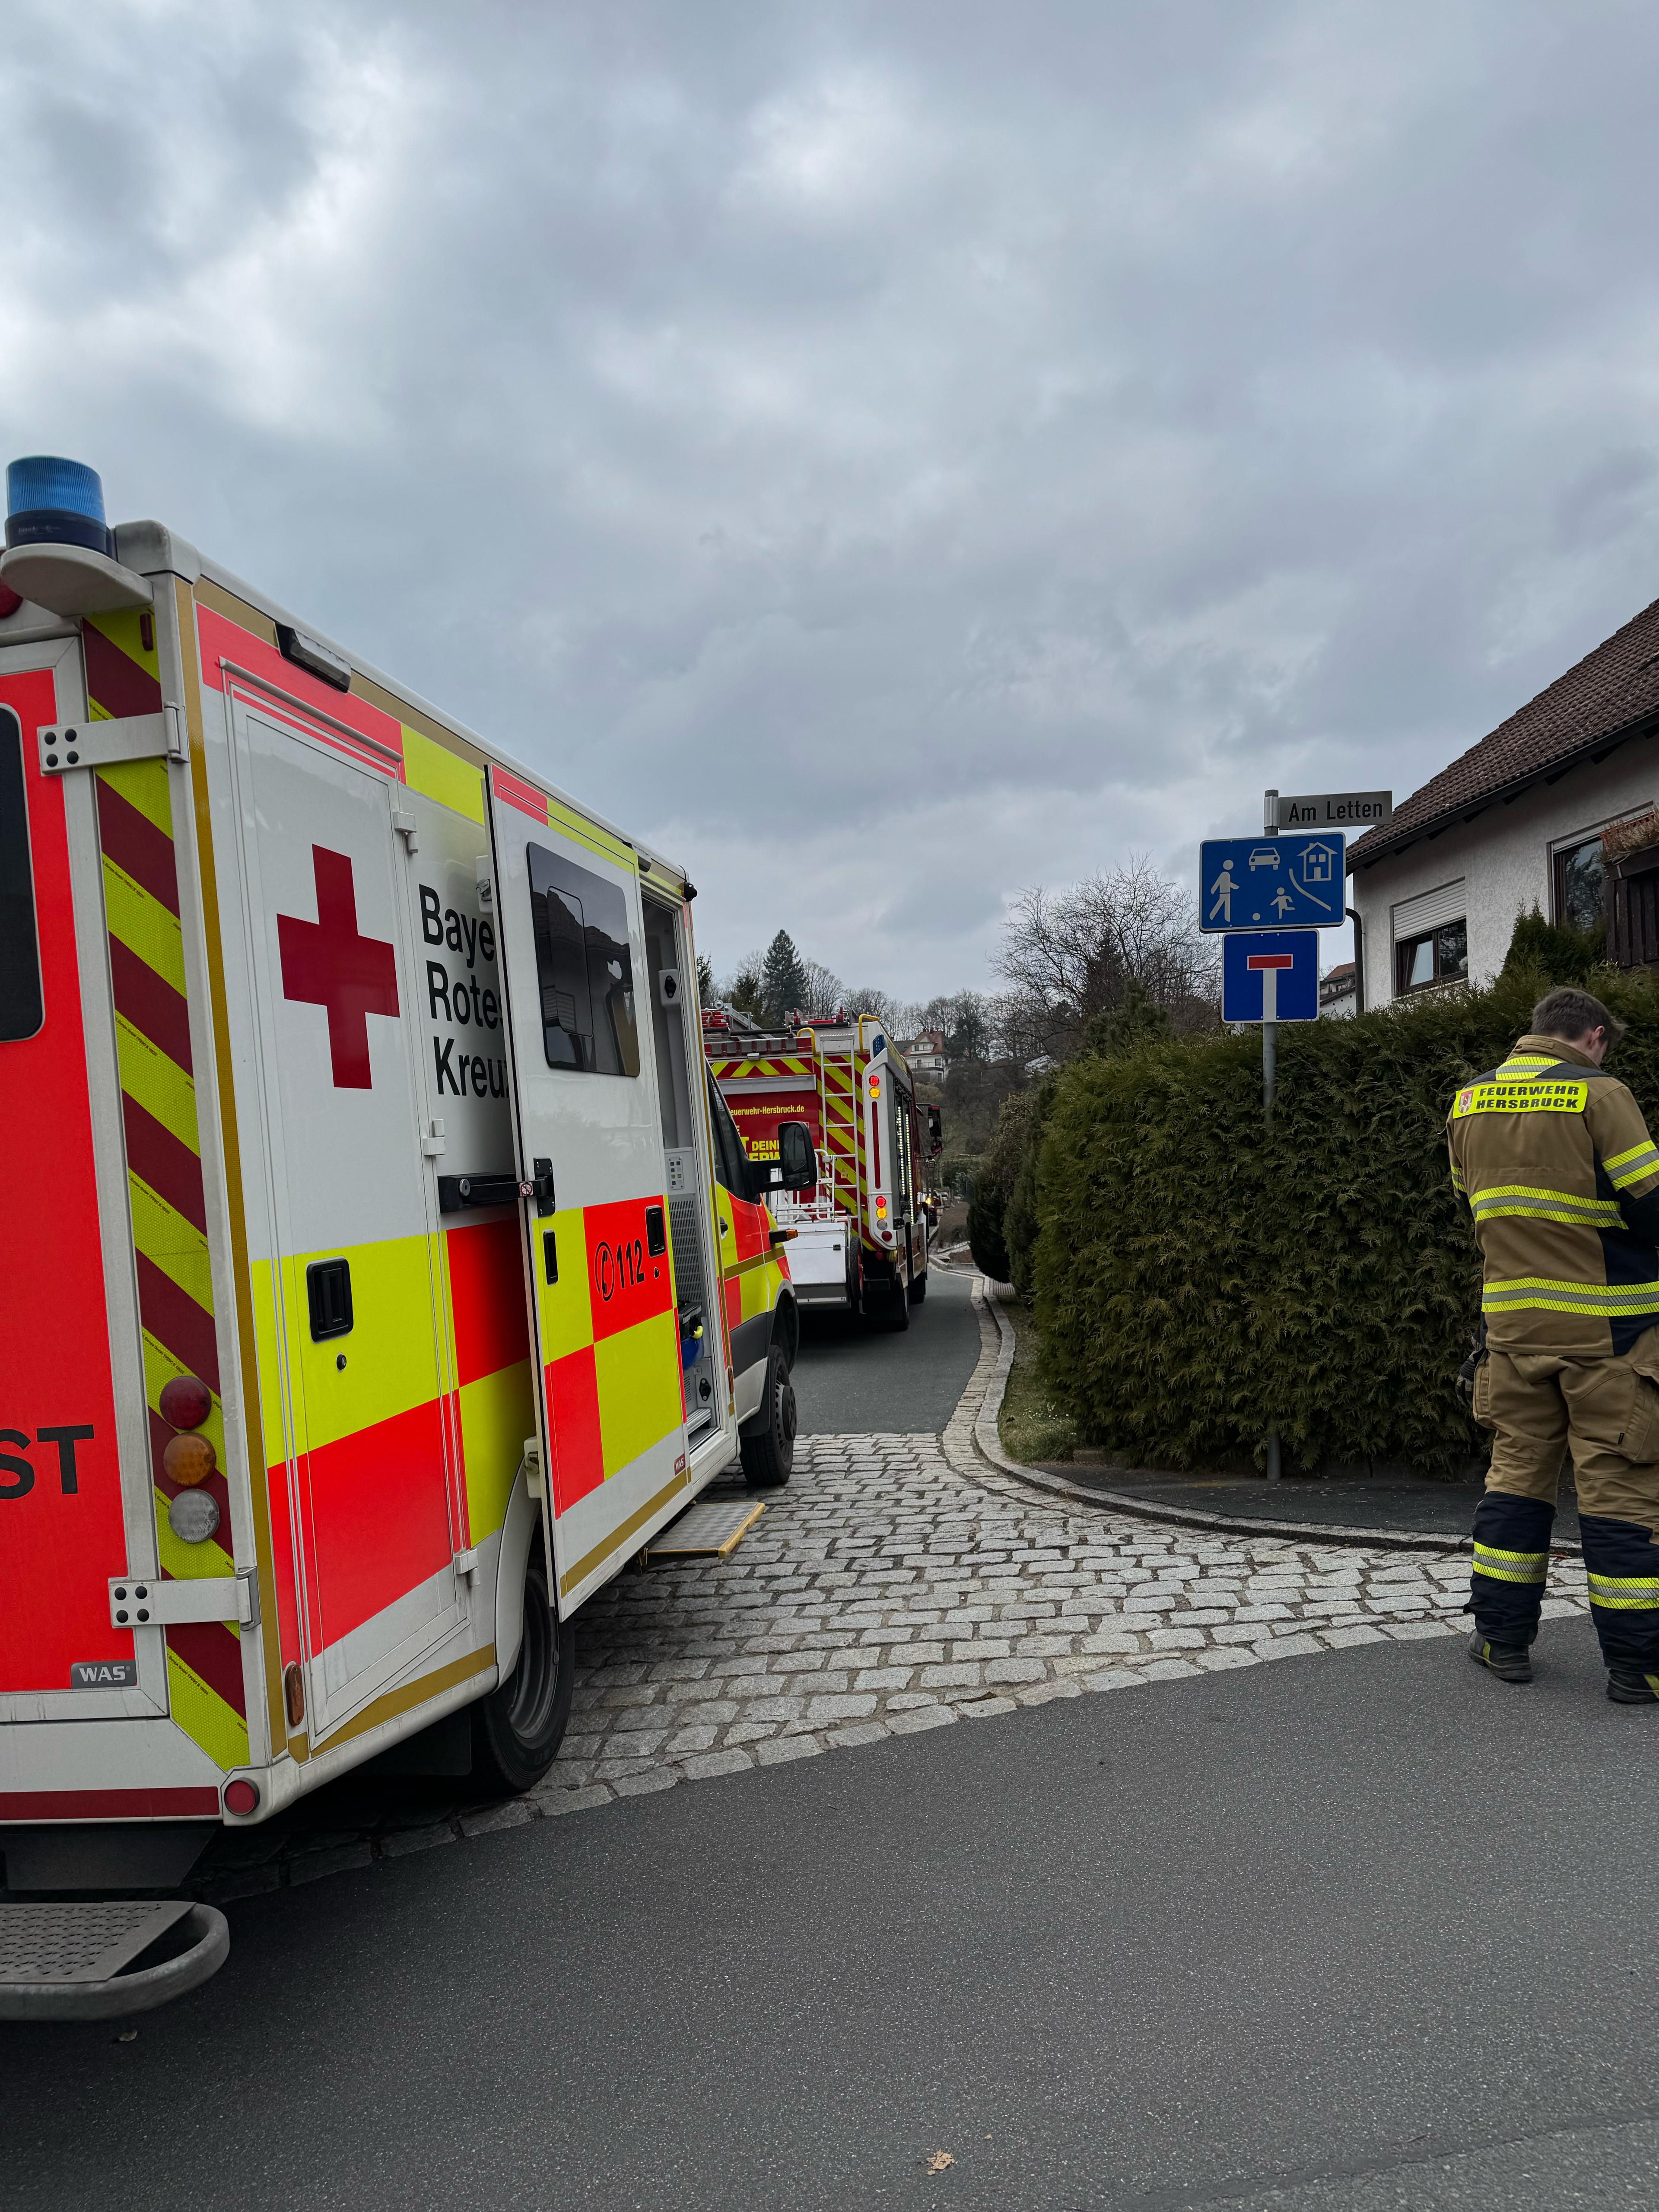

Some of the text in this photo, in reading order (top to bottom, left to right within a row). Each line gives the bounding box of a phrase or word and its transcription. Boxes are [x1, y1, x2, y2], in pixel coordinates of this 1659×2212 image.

[1288, 800, 1382, 822] Am Letten
[426, 960, 504, 1030] Rote
[433, 1036, 510, 1099] Kreu
[1475, 1097, 1580, 1109] HERSBRUCK
[1479, 1085, 1580, 1097] FEUERWEHR
[729, 1104, 805, 1116] euerwehr-Hersbruck.de
[617, 1239, 645, 1289] 112
[0, 1424, 95, 1500] ST
